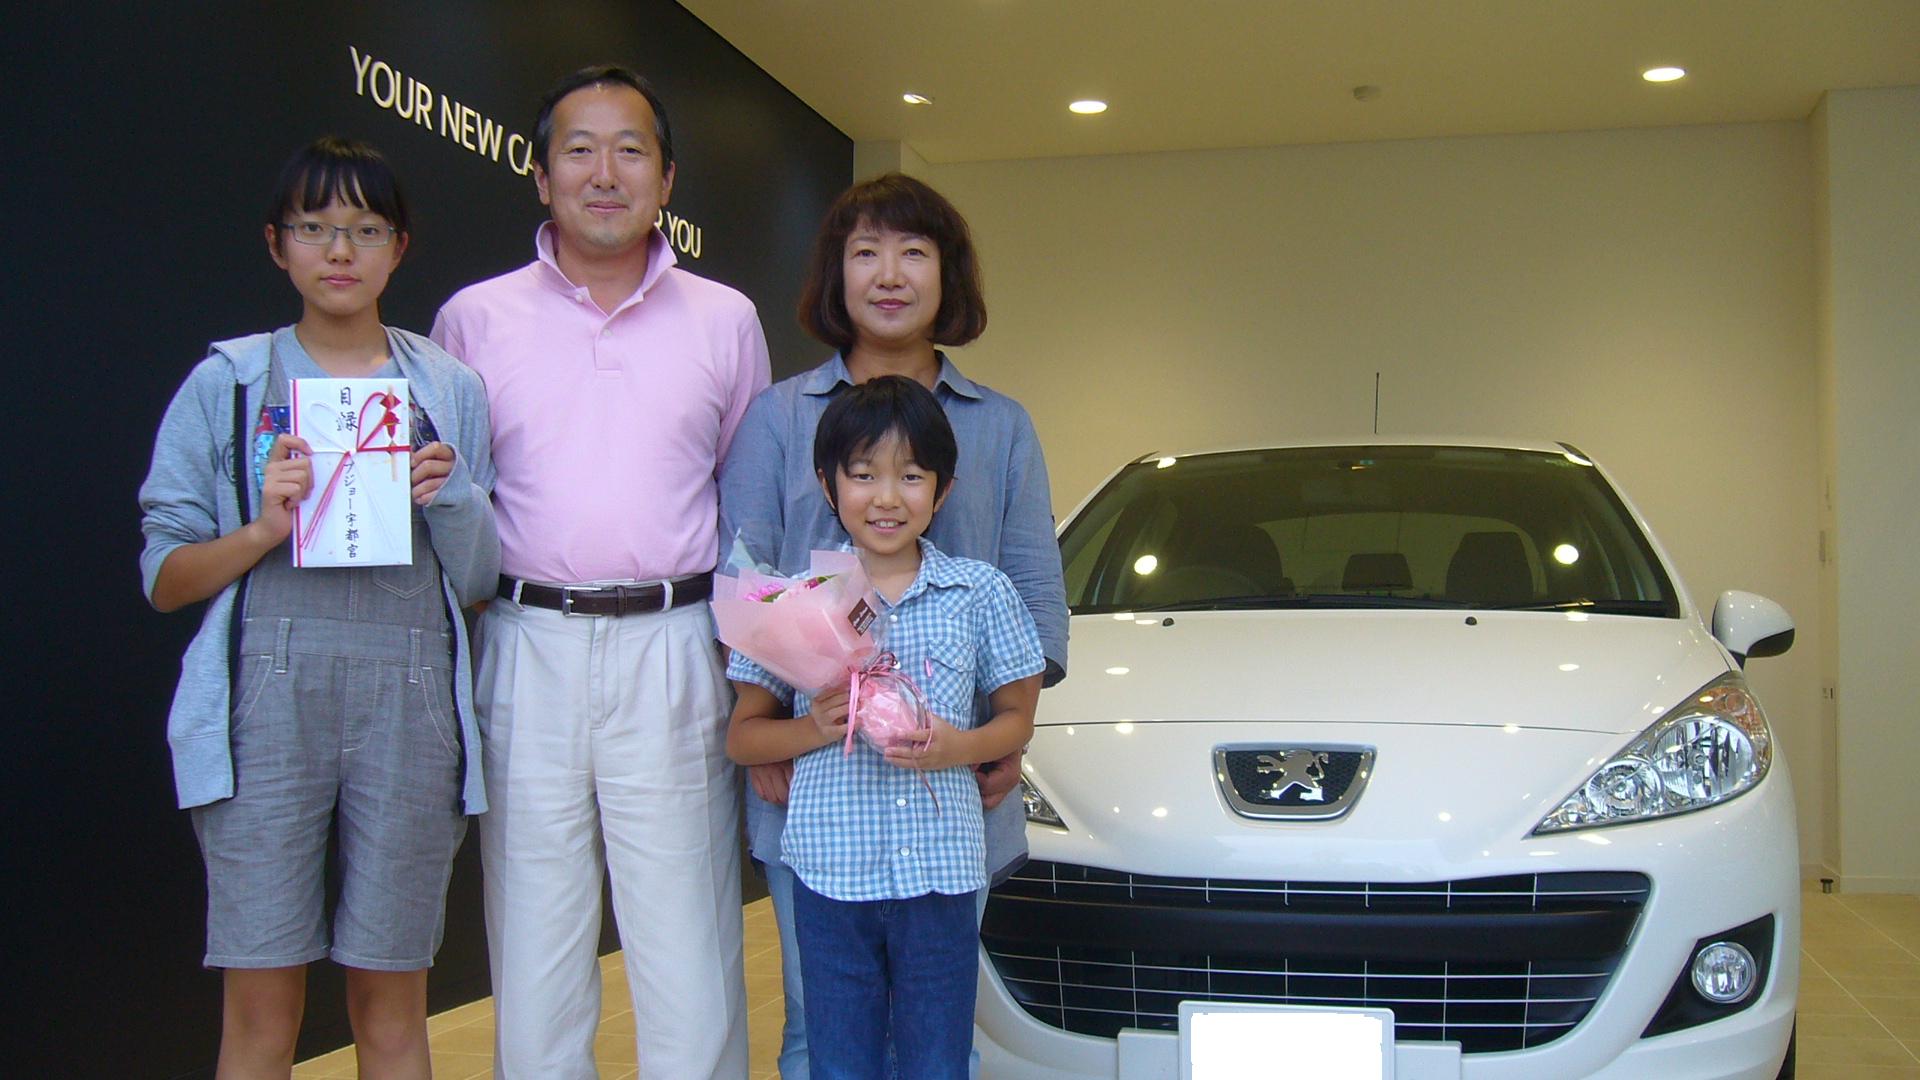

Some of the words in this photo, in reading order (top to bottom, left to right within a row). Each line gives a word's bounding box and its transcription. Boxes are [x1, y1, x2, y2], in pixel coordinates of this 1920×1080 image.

[350, 45, 433, 131] YOUR
[440, 94, 503, 163] NEW
[508, 133, 535, 177] CA
[666, 211, 702, 258] YOU
